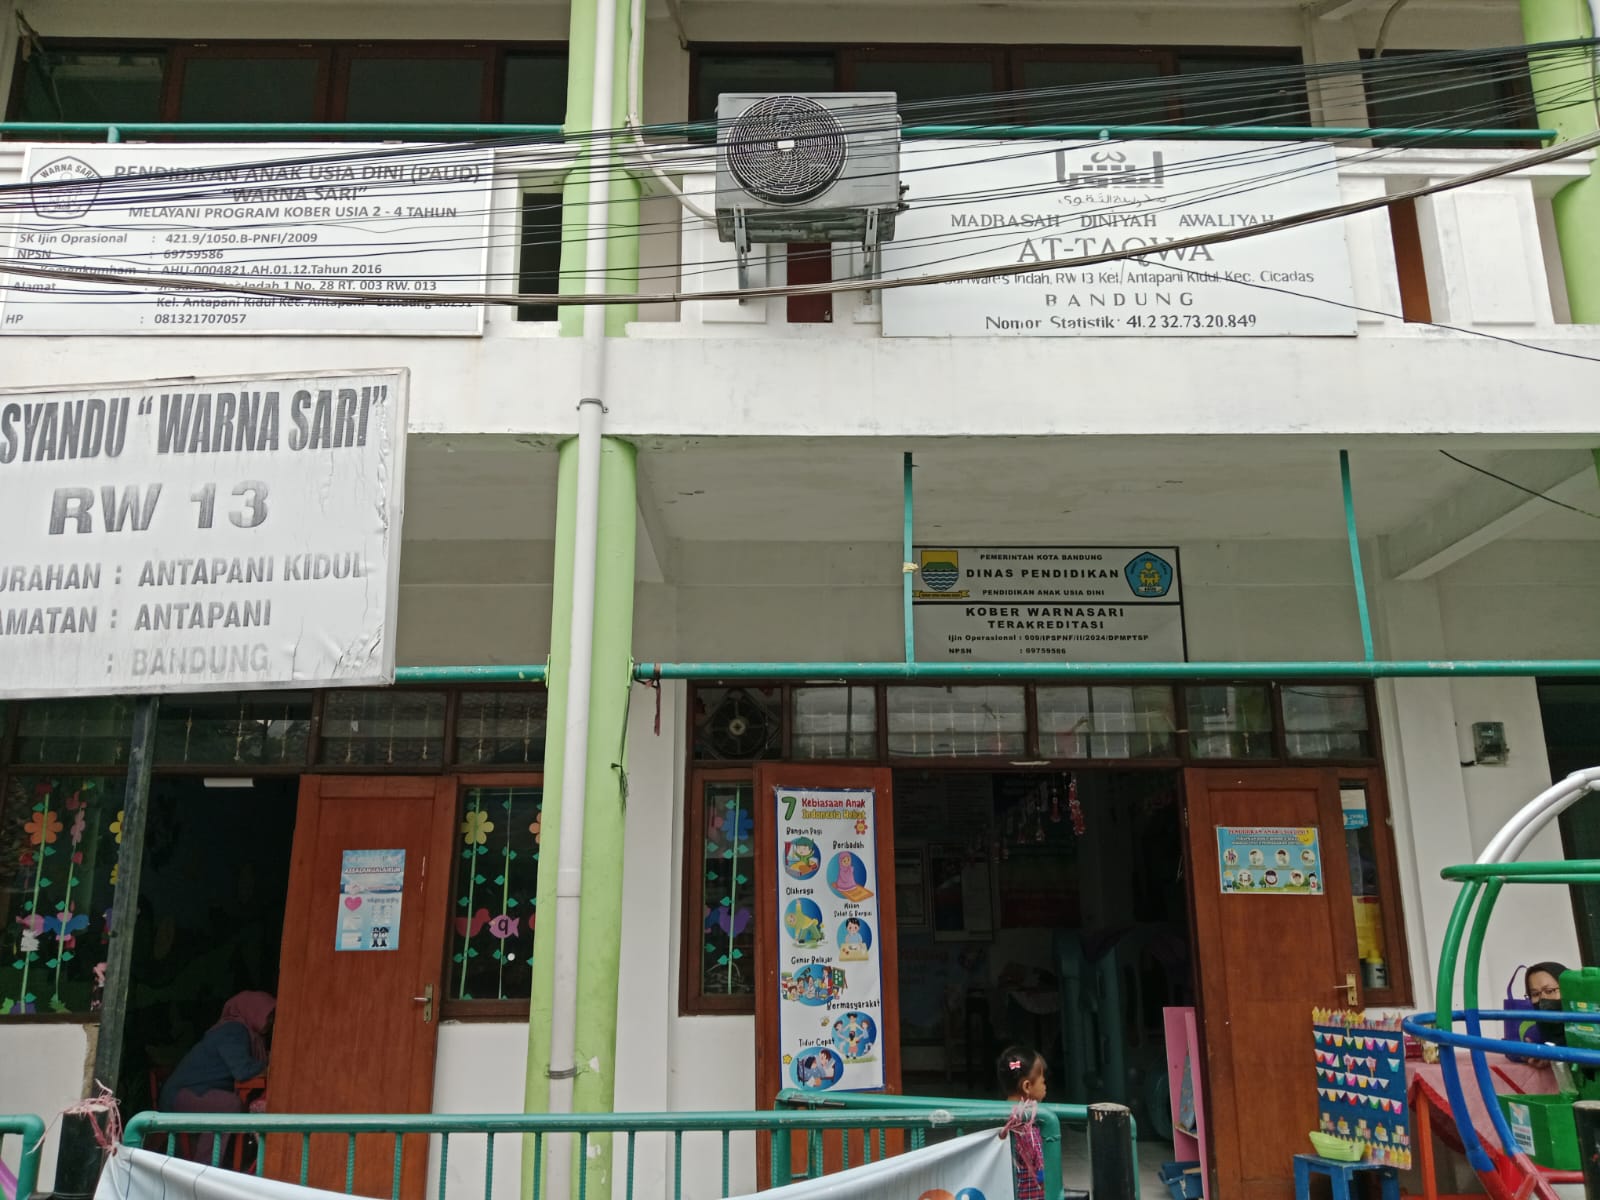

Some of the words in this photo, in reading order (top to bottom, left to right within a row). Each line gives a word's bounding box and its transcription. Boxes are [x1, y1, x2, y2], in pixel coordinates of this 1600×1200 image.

[40, 163, 73, 179] WARNA
[244, 167, 301, 182] ANAK
[309, 165, 354, 180] USIA
[362, 165, 405, 180] DINI
[411, 164, 479, 183] (PAUD)
[129, 207, 201, 218] MELAYANI
[205, 207, 279, 218] PROGRAM
[284, 206, 331, 217] KOBER
[335, 206, 369, 217] USIA
[373, 206, 381, 216] 2
[394, 206, 402, 217] 4
[407, 207, 457, 218] TAHUN
[951, 214, 1061, 228] MADRASAH
[1080, 214, 1157, 228] DINIYAH
[1178, 214, 1275, 227] AWALIYAH
[19, 233, 34, 243] SK
[38, 232, 57, 245] Ijin
[61, 232, 127, 246] Oprasional
[165, 233, 318, 245] 421.9/1050.B-PNFI/2009
[18, 249, 51, 260] NPSN
[163, 249, 224, 259] 69759586
[1017, 237, 1215, 266] AT-TAQWA
[352, 264, 382, 275] 2016
[1056, 272, 1077, 284] RW
[1081, 272, 1094, 284] 13
[1127, 271, 1183, 287] Antapani
[1225, 271, 1255, 283] Kec.
[1260, 270, 1314, 283] Cicadas
[14, 281, 57, 292] Alamat
[294, 280, 313, 290] No.
[319, 280, 334, 290] 28
[338, 280, 356, 290] RT.
[360, 280, 382, 290] 003
[386, 280, 410, 290] RW.
[414, 280, 437, 291] 013
[156, 297, 179, 308] Kel.
[183, 297, 240, 310] Antapani
[244, 297, 275, 308] Kidul
[1045, 292, 1194, 307] BANDUNG
[5, 314, 24, 324] HP
[154, 313, 247, 325] 081321707057
[0, 397, 130, 464] SYANDU
[48, 483, 163, 535] RW
[190, 480, 270, 530] 13
[138, 555, 274, 588] ANTAPANI
[283, 551, 368, 582] KIDUL
[966, 569, 1014, 578] DINAS
[1021, 569, 1119, 578] PENDIDIKAN
[0, 605, 98, 636] MATAN
[134, 599, 273, 632] ANTAPANI
[966, 607, 1020, 616] KOBER
[1027, 607, 1124, 617] WARNASARI
[987, 620, 1105, 629] TERAKREDITASI
[948, 634, 963, 642] Ijin
[965, 634, 1016, 642] Operasional
[131, 642, 270, 676] BANDUNG
[781, 796, 797, 821] 7
[801, 797, 843, 808] Kebiasaan
[845, 797, 866, 808] Anak
[786, 887, 814, 896] Olahraga
[826, 998, 881, 1011] Bermasyarakat
[798, 1038, 815, 1047] Tidur
